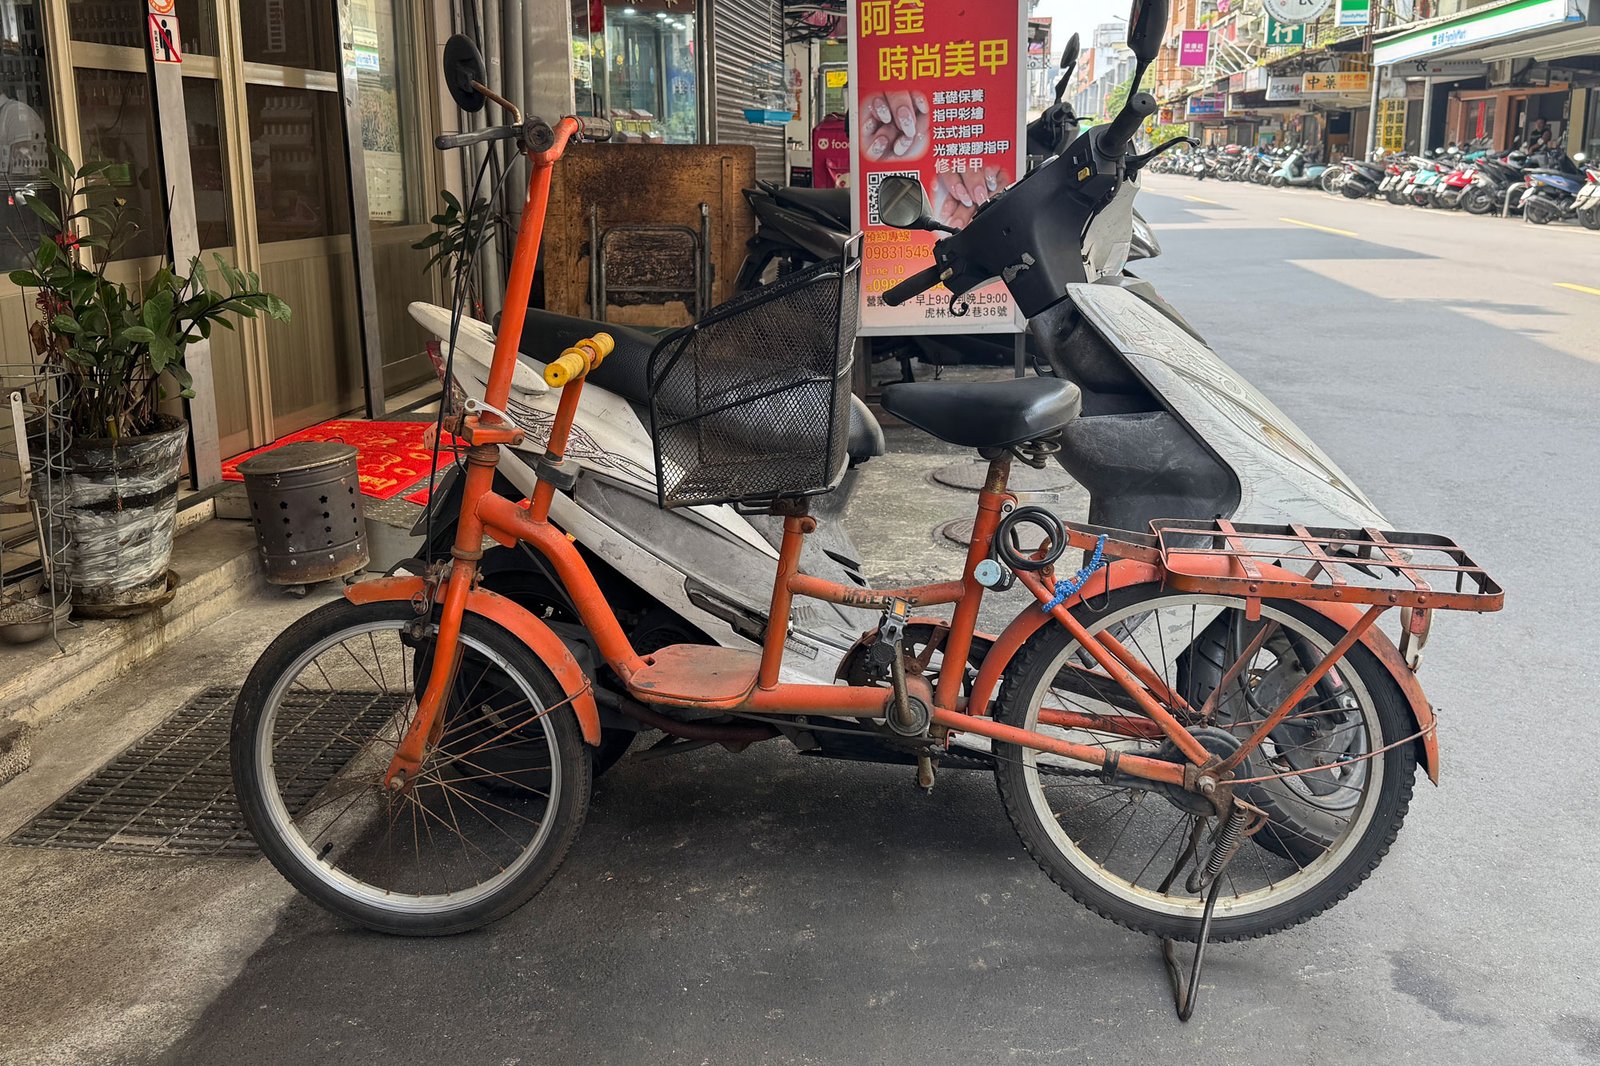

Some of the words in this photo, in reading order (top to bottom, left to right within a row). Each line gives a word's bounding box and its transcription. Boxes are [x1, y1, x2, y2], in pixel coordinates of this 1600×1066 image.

[860, 0, 926, 38] 阿金
[1271, 22, 1300, 44] 行
[878, 38, 1009, 82] 時尚美甲
[932, 88, 985, 105] 基礎保養
[932, 106, 984, 122] 指甲彩繪
[932, 124, 984, 140] 法式指甲
[932, 140, 1010, 157] 光療凝膠指甲
[934, 158, 984, 174] 修指甲
[865, 245, 934, 260] 09831545
[865, 266, 888, 275] Line
[893, 264, 905, 275] ID
